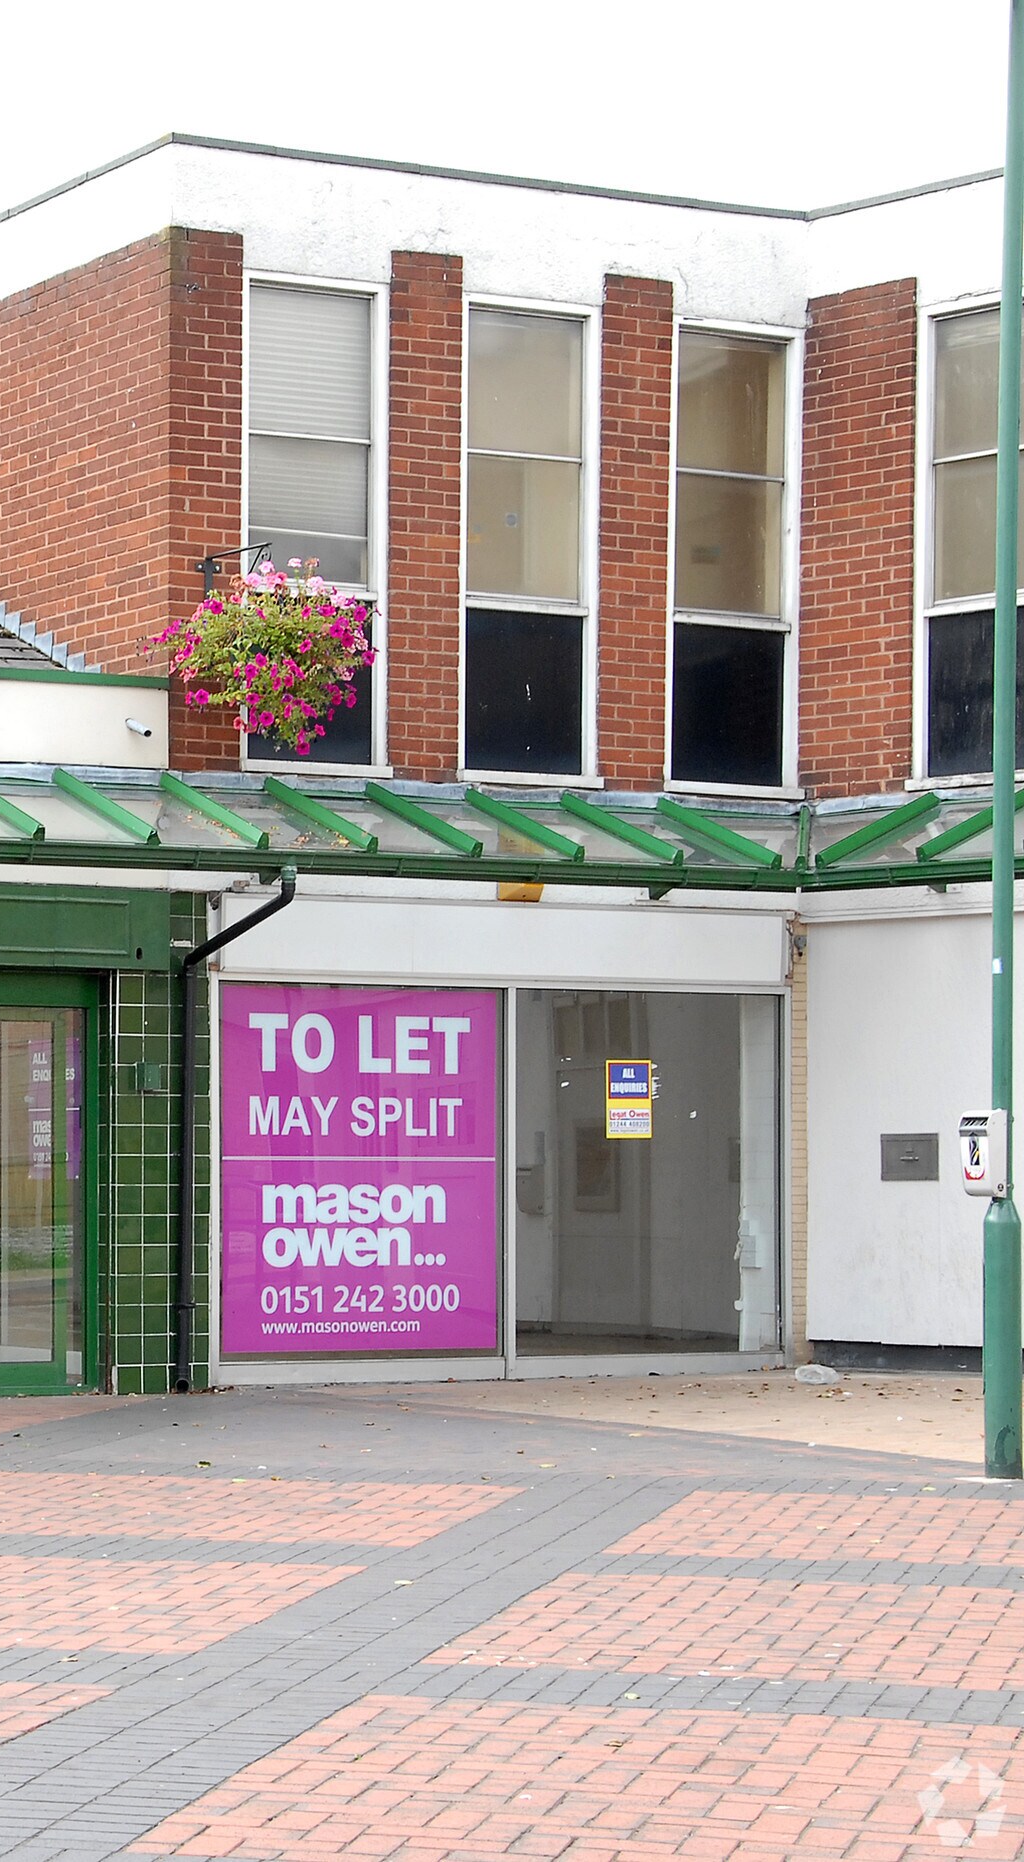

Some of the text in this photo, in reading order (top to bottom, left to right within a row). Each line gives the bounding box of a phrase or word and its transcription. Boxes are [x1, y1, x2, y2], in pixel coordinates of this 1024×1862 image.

[248, 1012, 471, 1075] TO LET
[32, 1052, 48, 1065] ALL
[622, 1068, 635, 1079] ALL
[610, 1083, 648, 1094] ENQUIRIES
[248, 1095, 463, 1137] MAY SPLIT
[609, 1110, 649, 1120] Legat Owen
[32, 1119, 51, 1134] mas
[262, 1183, 447, 1224] mason
[262, 1226, 447, 1268] owen...
[260, 1284, 460, 1315] 0151 242 3000
[261, 1319, 421, 1335] www.masonowen.com
